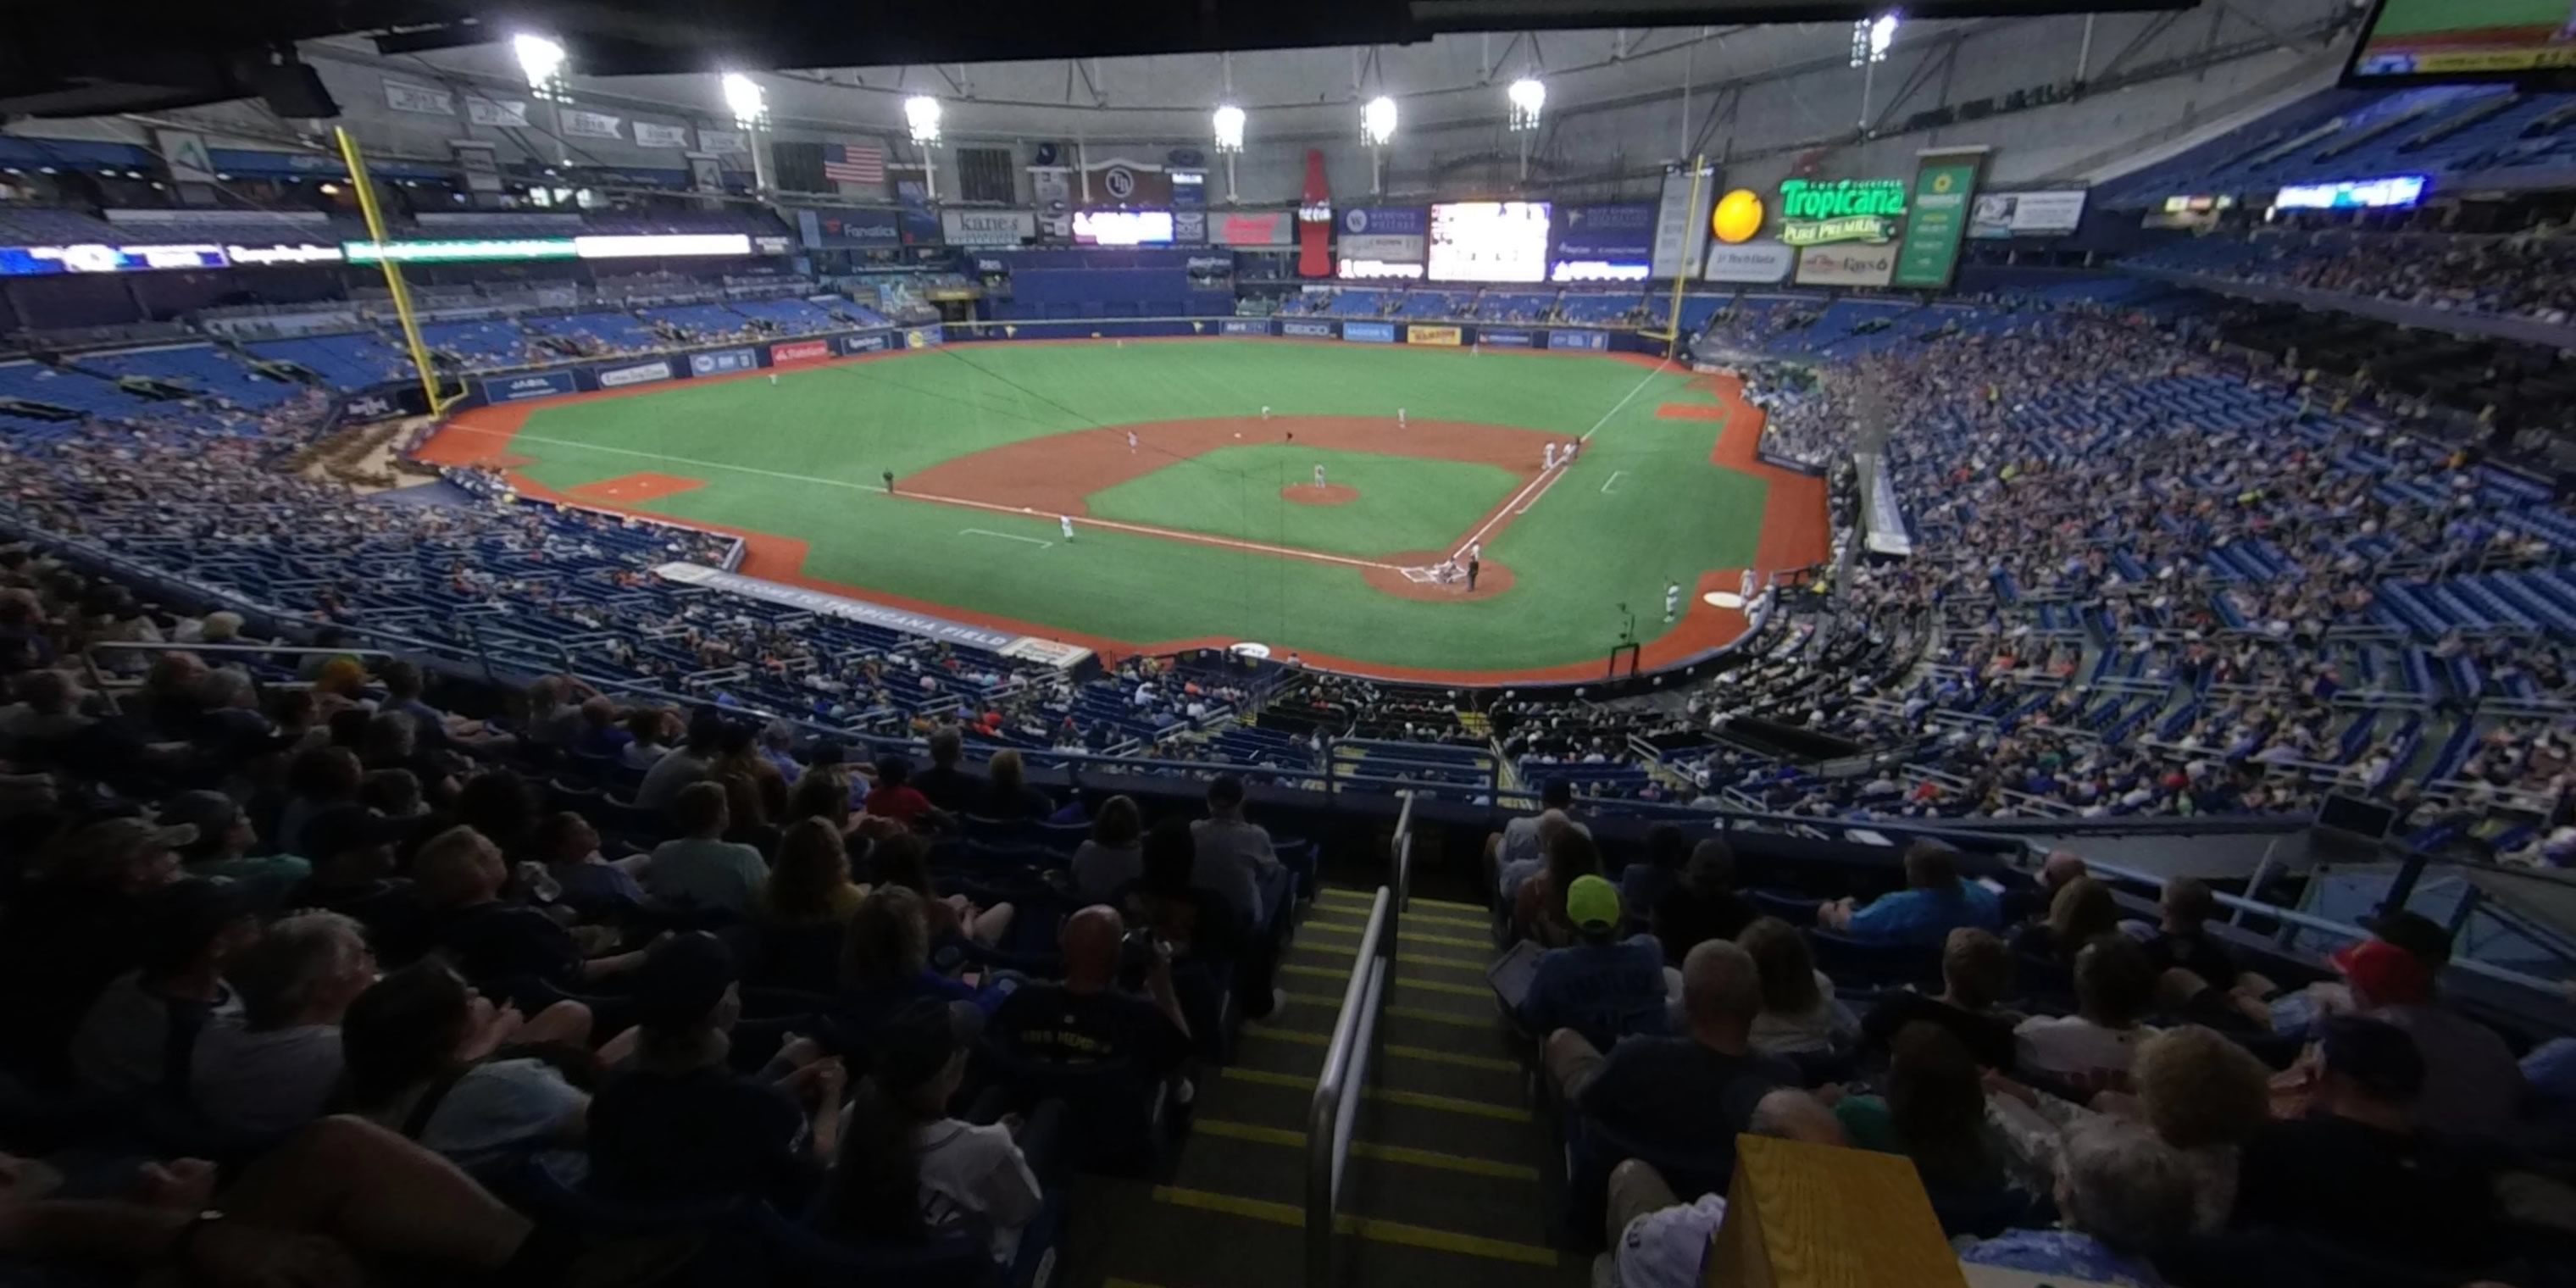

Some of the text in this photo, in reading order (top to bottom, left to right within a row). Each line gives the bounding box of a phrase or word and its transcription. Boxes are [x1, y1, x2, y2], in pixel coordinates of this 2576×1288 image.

[1780, 179, 1906, 219] Tropicana
[843, 223, 897, 237] Fanatics
[1784, 219, 1881, 241] PURE PREMIUM
[1284, 324, 1329, 336] GEICO
[824, 601, 936, 631] TROPICANA
[939, 626, 1007, 647] FIELD
